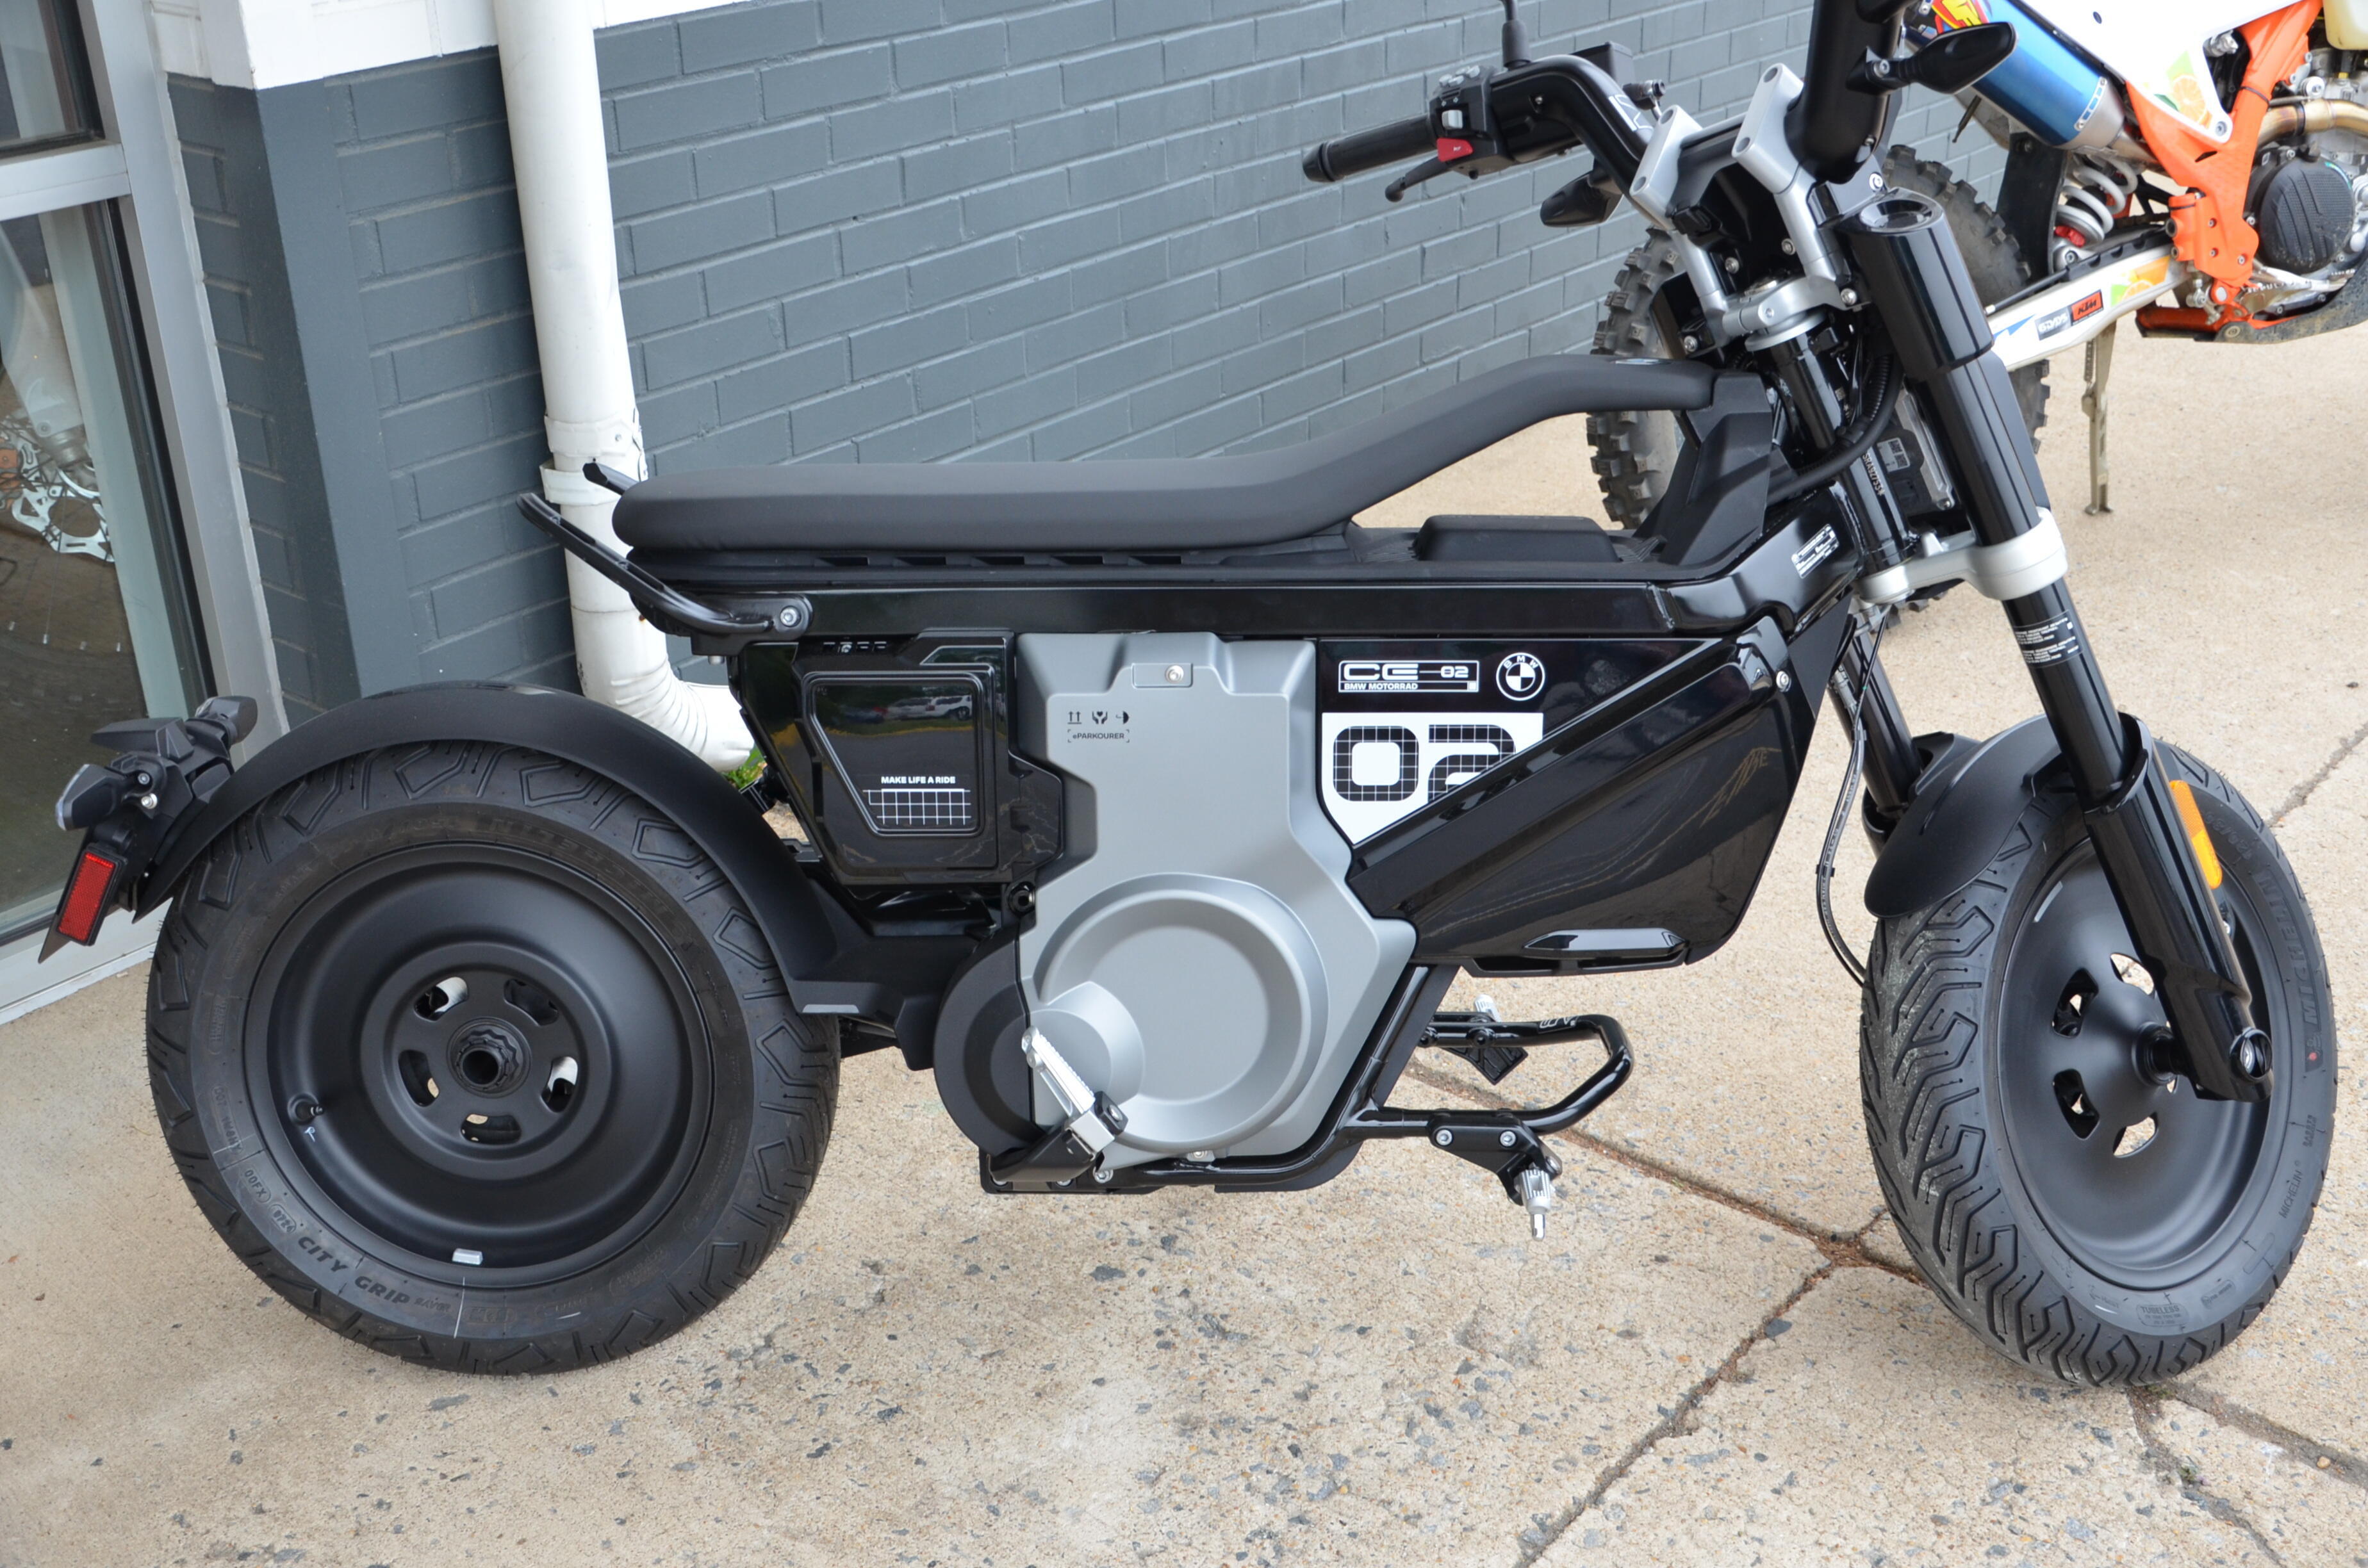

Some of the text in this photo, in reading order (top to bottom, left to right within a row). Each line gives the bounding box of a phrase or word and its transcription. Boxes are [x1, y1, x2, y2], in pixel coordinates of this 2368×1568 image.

[2077, 300, 2097, 314] KTM
[1344, 682, 1418, 690] BMW MOTORRAD
[881, 776, 956, 784] MAKE LIFE A RIDE
[1333, 724, 1517, 803] 02
[2257, 869, 2323, 1030] MICHELIN
[215, 1087, 228, 1108] DOT
[2278, 1169, 2303, 1219] MICHELIN
[297, 1236, 349, 1273] CITY
[354, 1275, 410, 1304] GRIP
